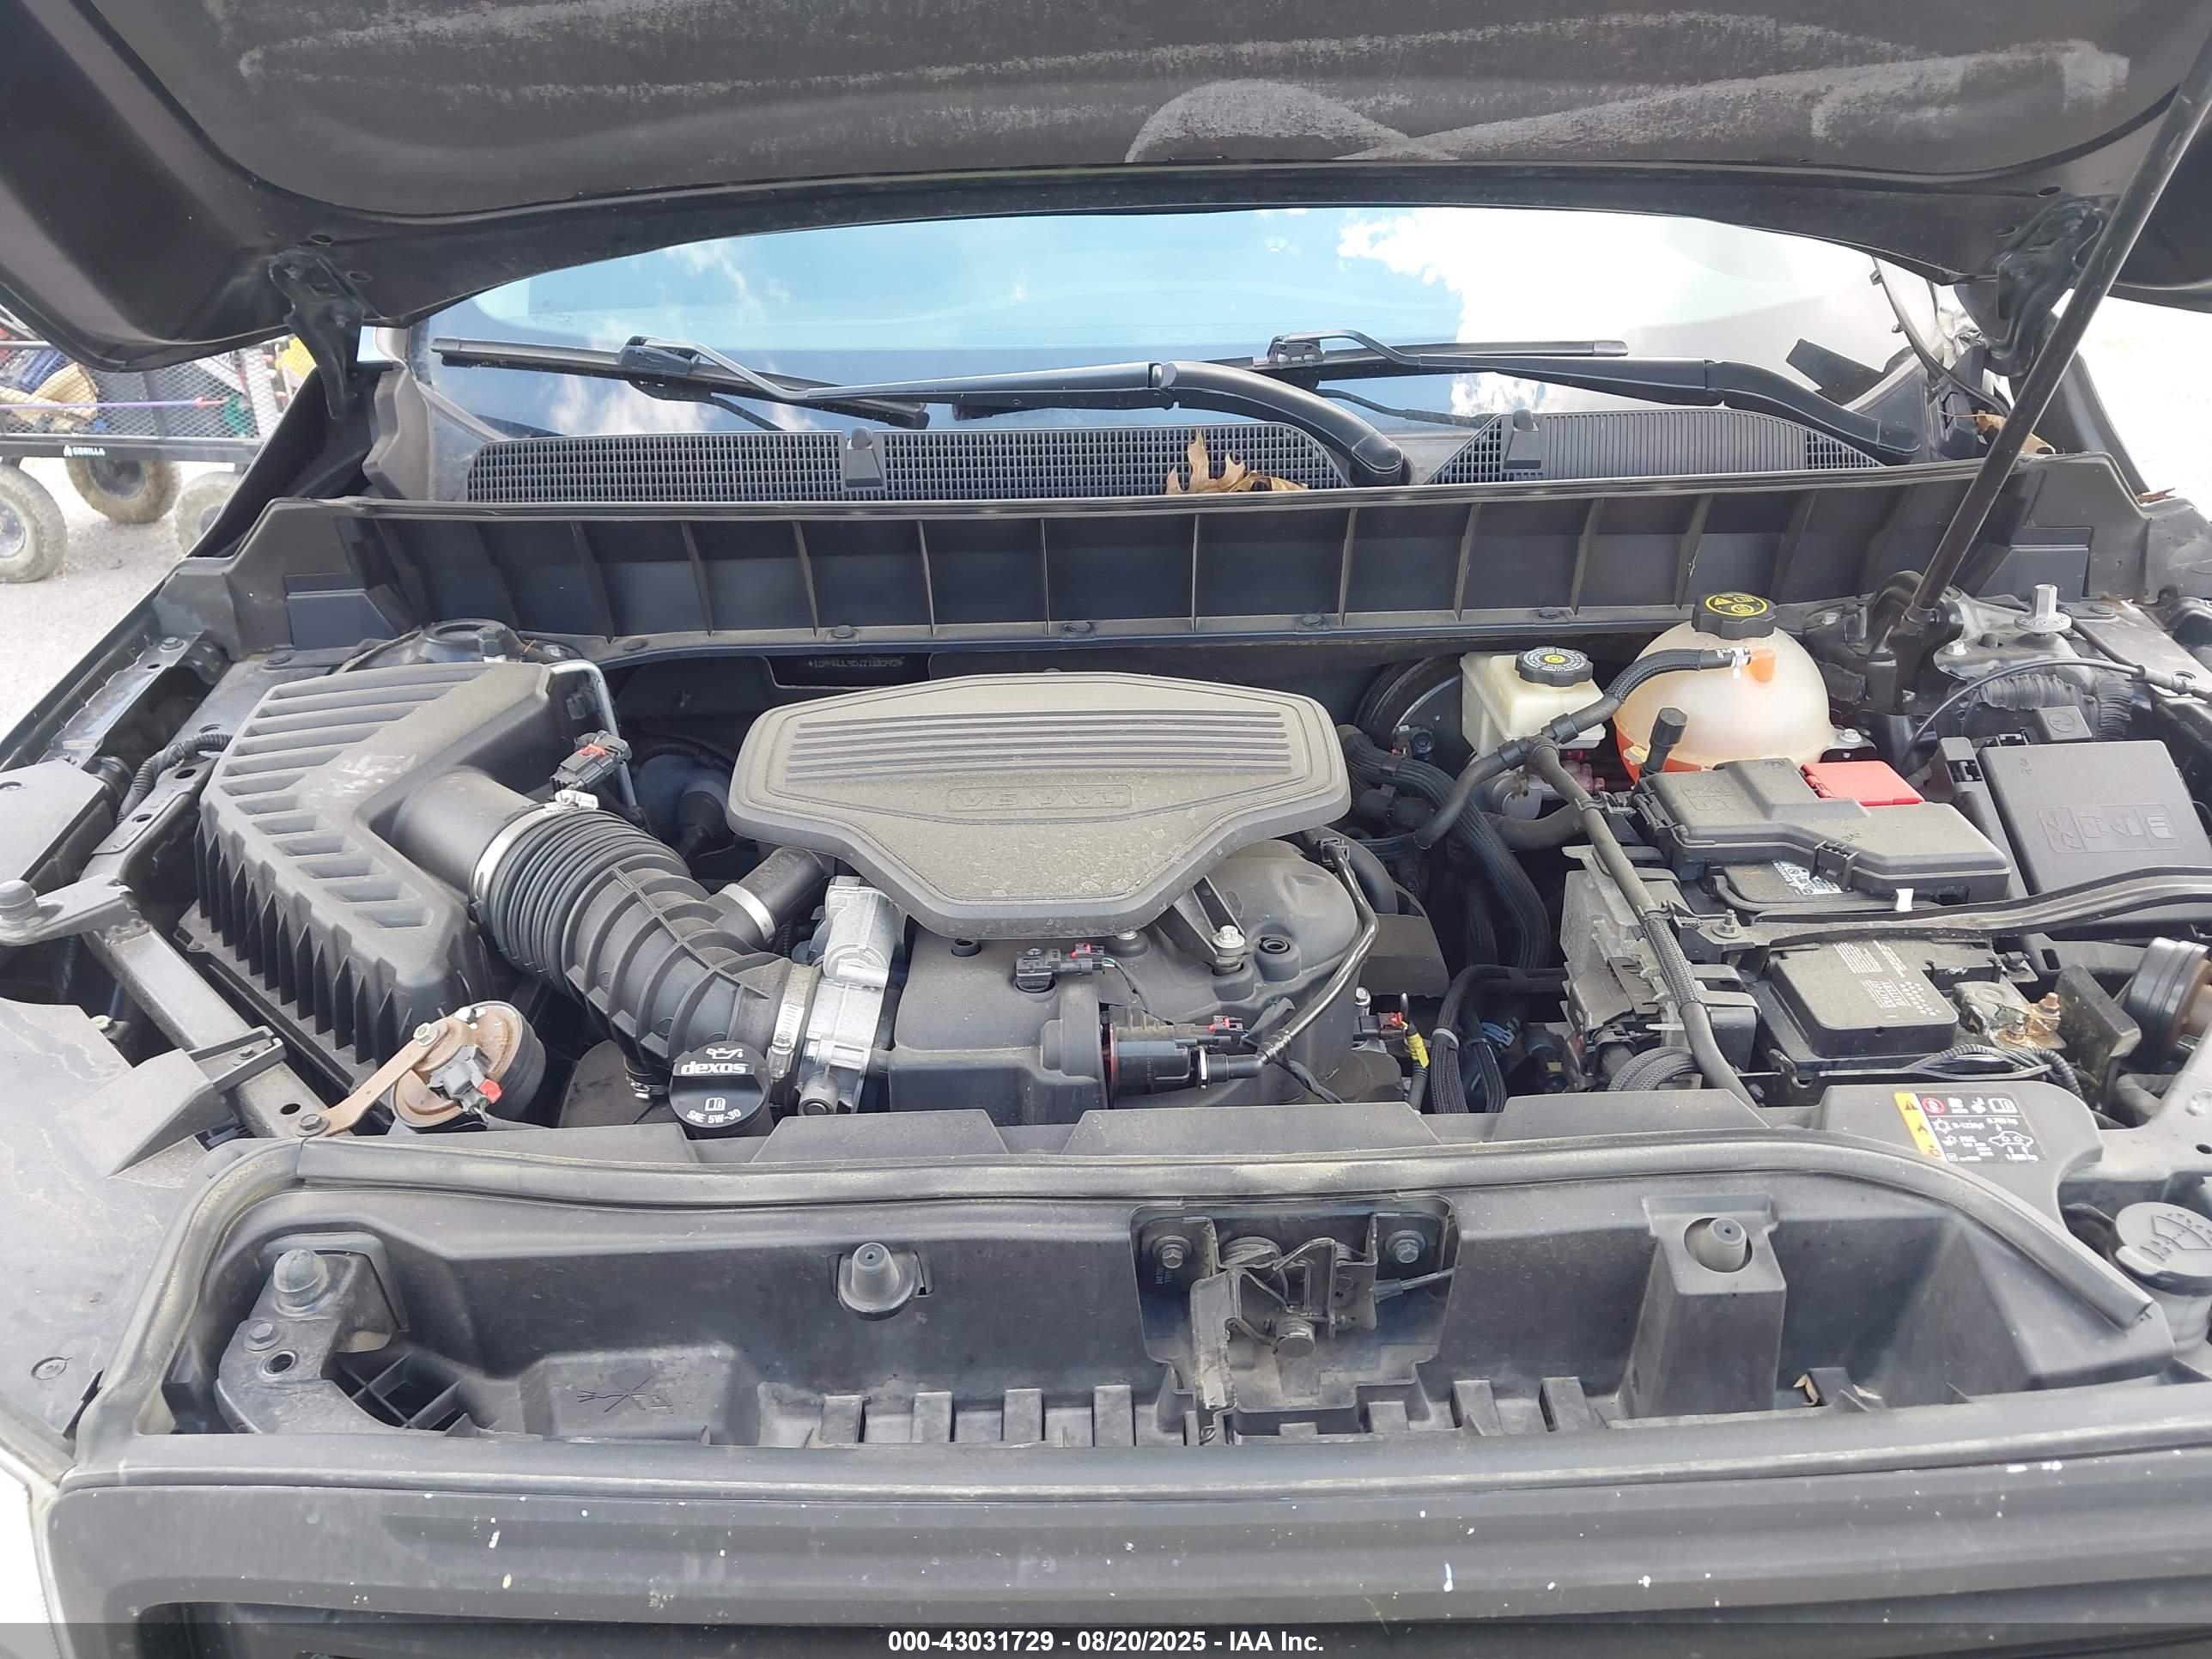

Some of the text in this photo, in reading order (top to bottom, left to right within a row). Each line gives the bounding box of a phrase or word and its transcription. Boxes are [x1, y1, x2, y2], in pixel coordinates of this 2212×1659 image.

[73, 447, 106, 457] GORILLA
[680, 1060, 749, 1074] dexos
[686, 1109, 742, 1124] SAE 5W-30
